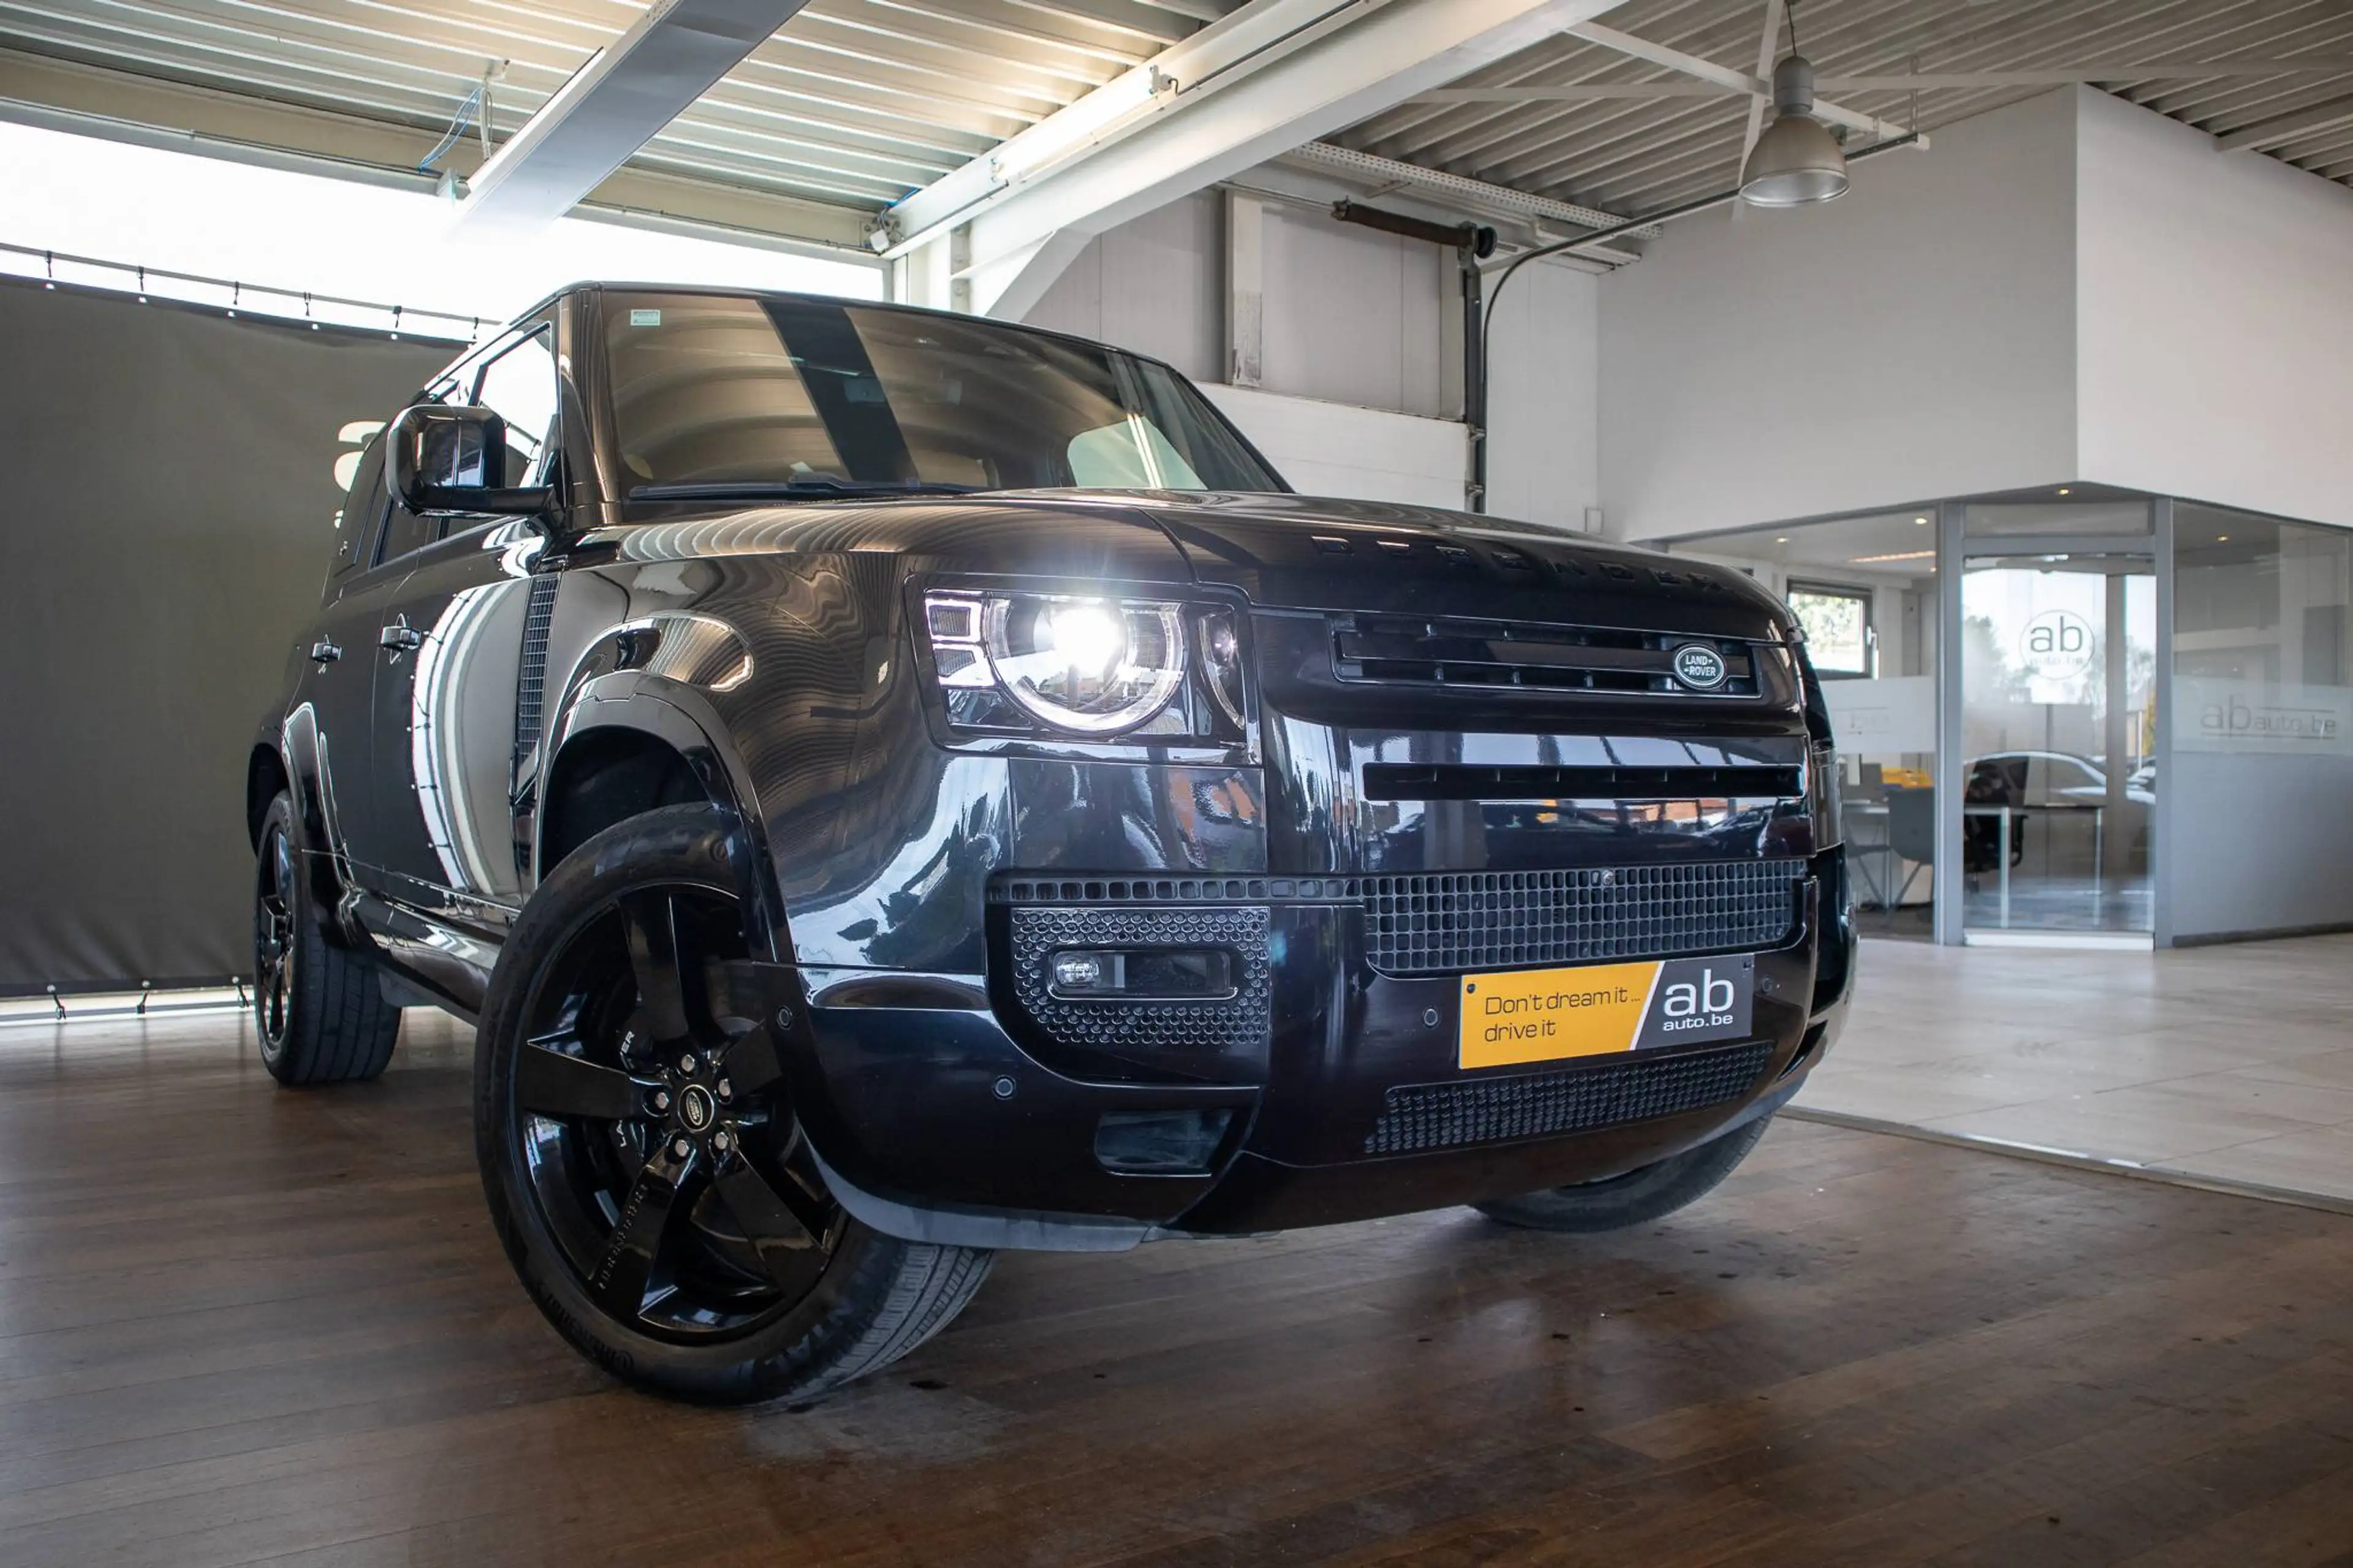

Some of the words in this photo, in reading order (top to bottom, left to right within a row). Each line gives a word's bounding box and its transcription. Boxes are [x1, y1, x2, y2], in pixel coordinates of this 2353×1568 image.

[2029, 615, 2083, 652] ab
[1685, 654, 1708, 665] LAND
[1689, 666, 1716, 676] ROVER
[1485, 993, 1542, 1015] Don't
[1546, 991, 1610, 1010] dream
[1664, 969, 1734, 1017] ab
[1484, 1022, 1537, 1042] drive
[1542, 1019, 1556, 1037] it
[1663, 1013, 1733, 1031] auto.be
